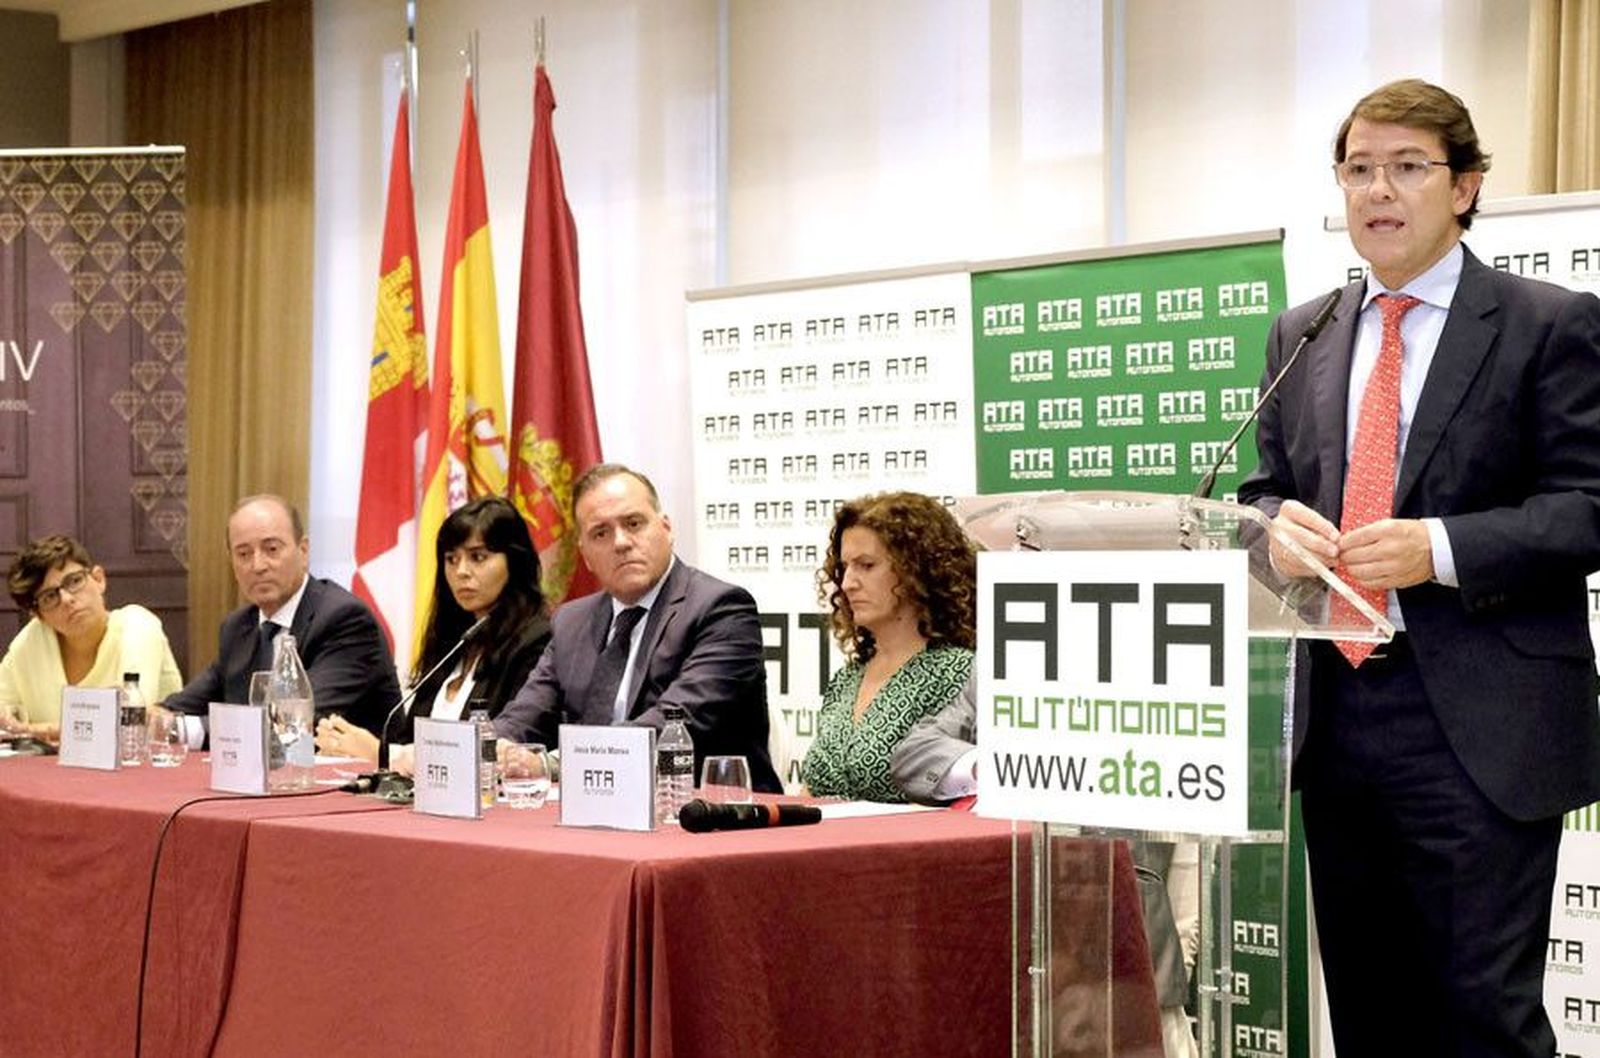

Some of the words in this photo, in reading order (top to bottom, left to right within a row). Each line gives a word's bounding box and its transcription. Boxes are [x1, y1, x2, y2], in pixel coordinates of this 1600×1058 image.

[1494, 253, 1549, 275] ATA
[1572, 248, 1600, 271] AT
[984, 302, 1024, 327] ATA
[1038, 298, 1082, 322] ATA
[1096, 292, 1141, 318] ATA
[1157, 287, 1203, 313] ATA
[1219, 281, 1268, 307] ATA
[703, 327, 740, 346] ATA
[754, 322, 792, 341] ATA
[806, 317, 844, 336] ATA
[859, 312, 899, 332] ATA
[915, 307, 955, 328] ATA
[1011, 349, 1053, 373] ATA
[1067, 345, 1112, 369] ATA
[1126, 341, 1173, 366] ATA
[1189, 336, 1234, 362] ATA
[728, 369, 765, 388] ATA
[781, 365, 817, 384] ATA
[833, 360, 870, 380] ATA
[886, 356, 927, 377] ATA
[705, 415, 740, 433] ATA
[754, 412, 793, 430] ATA
[806, 408, 845, 427] ATA
[859, 405, 898, 424] ATA
[915, 401, 957, 421] ATA
[984, 400, 1024, 423] ATA
[1038, 397, 1082, 420] ATA
[1097, 394, 1143, 417] ATA
[1159, 391, 1206, 414] ATA
[729, 457, 767, 475] ATA
[783, 455, 817, 473] ATA
[833, 452, 870, 471] ATA
[885, 450, 927, 469] ATA
[1010, 448, 1053, 471] ATA
[1068, 445, 1112, 468] ATA
[1128, 443, 1175, 467] ATA
[1191, 441, 1238, 464] ATA
[707, 503, 740, 520] ATA
[755, 501, 793, 519] ATA
[729, 546, 769, 564] ATA
[783, 545, 817, 562] ATA
[993, 583, 1225, 687] ATA
[583, 769, 614, 788] ATA
[994, 749, 1226, 801] www.ata.es
[1566, 884, 1600, 908] AT
[1233, 920, 1279, 947] ATA
[1548, 938, 1583, 964] TA
[1565, 997, 1600, 1022] AT
[1236, 1024, 1282, 1055] ATA
